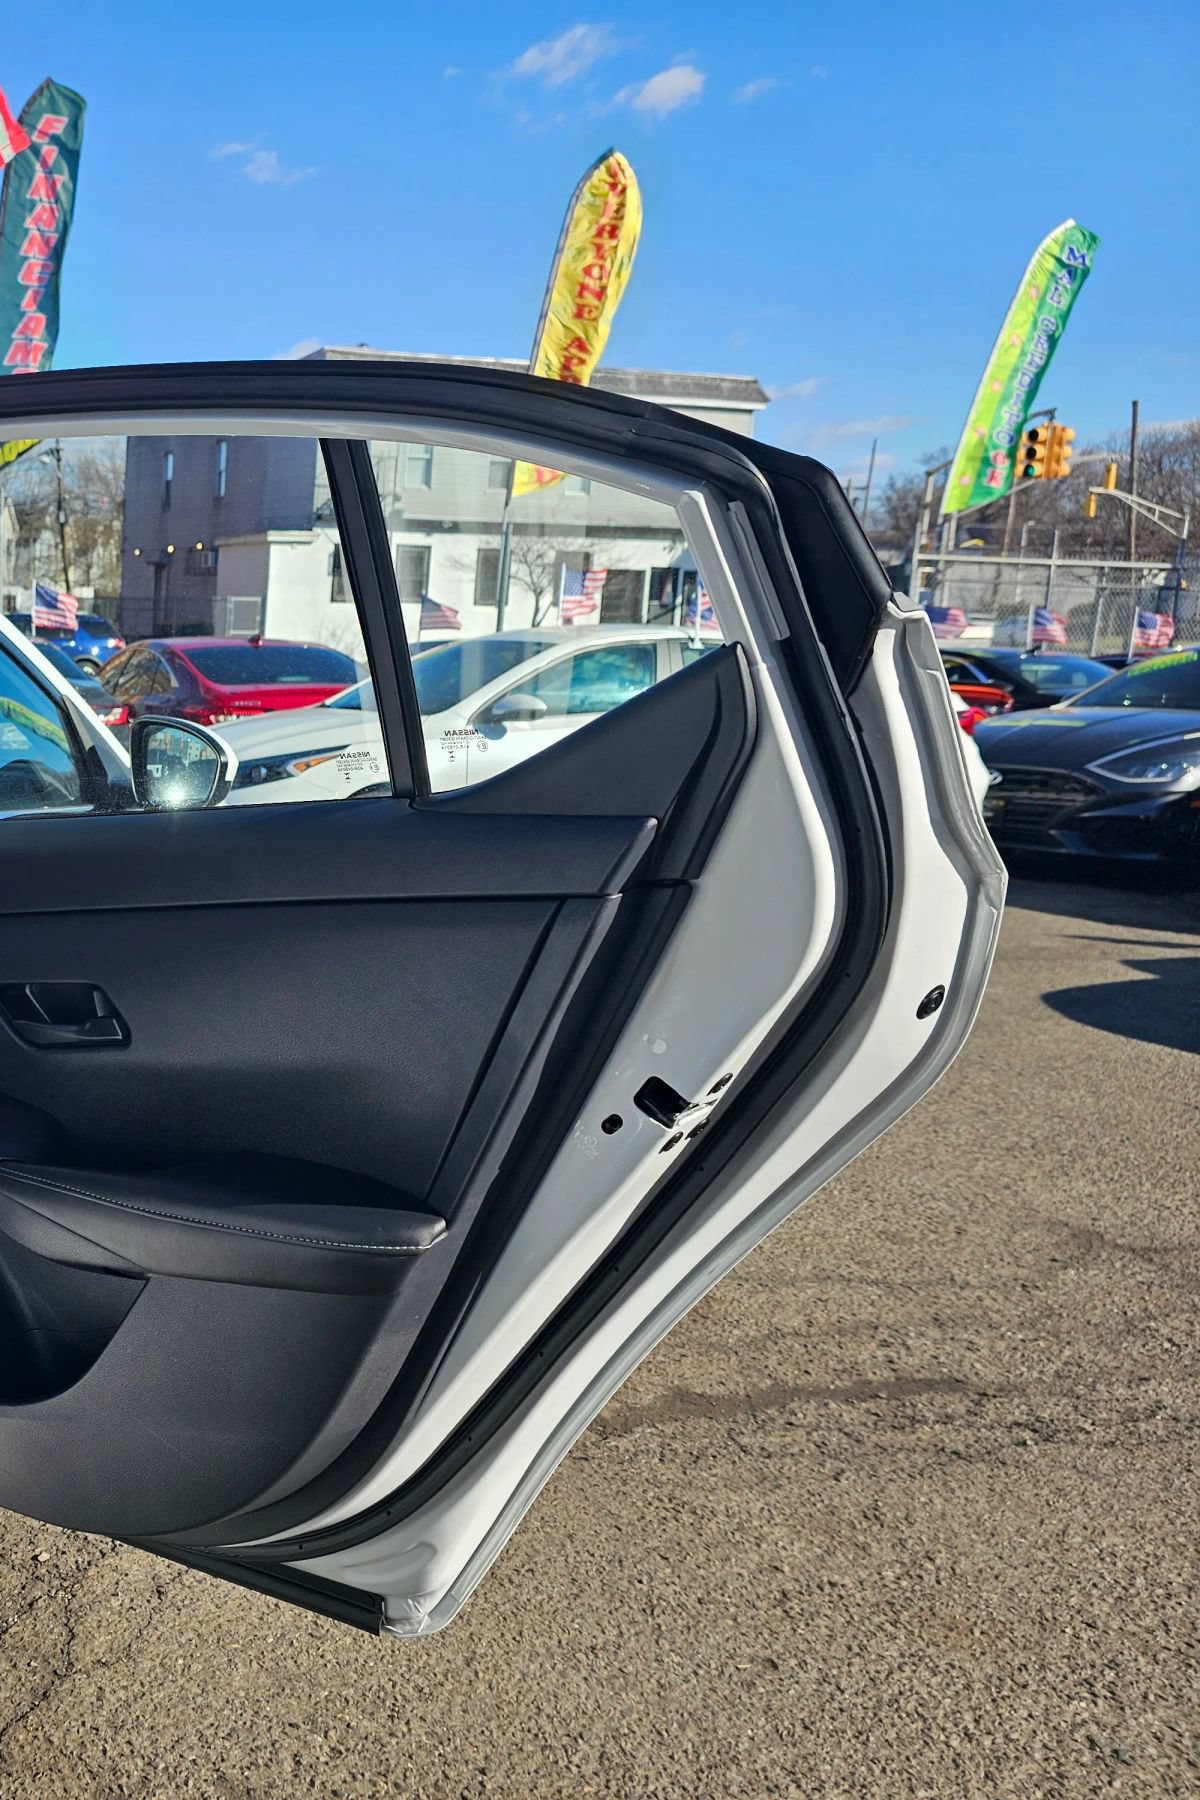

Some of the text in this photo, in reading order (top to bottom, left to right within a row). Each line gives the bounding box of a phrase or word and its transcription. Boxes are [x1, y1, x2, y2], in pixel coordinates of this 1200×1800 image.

[3, 113, 68, 375] FINANCIAM
[986, 245, 1089, 489] MAL CREDITO OK
